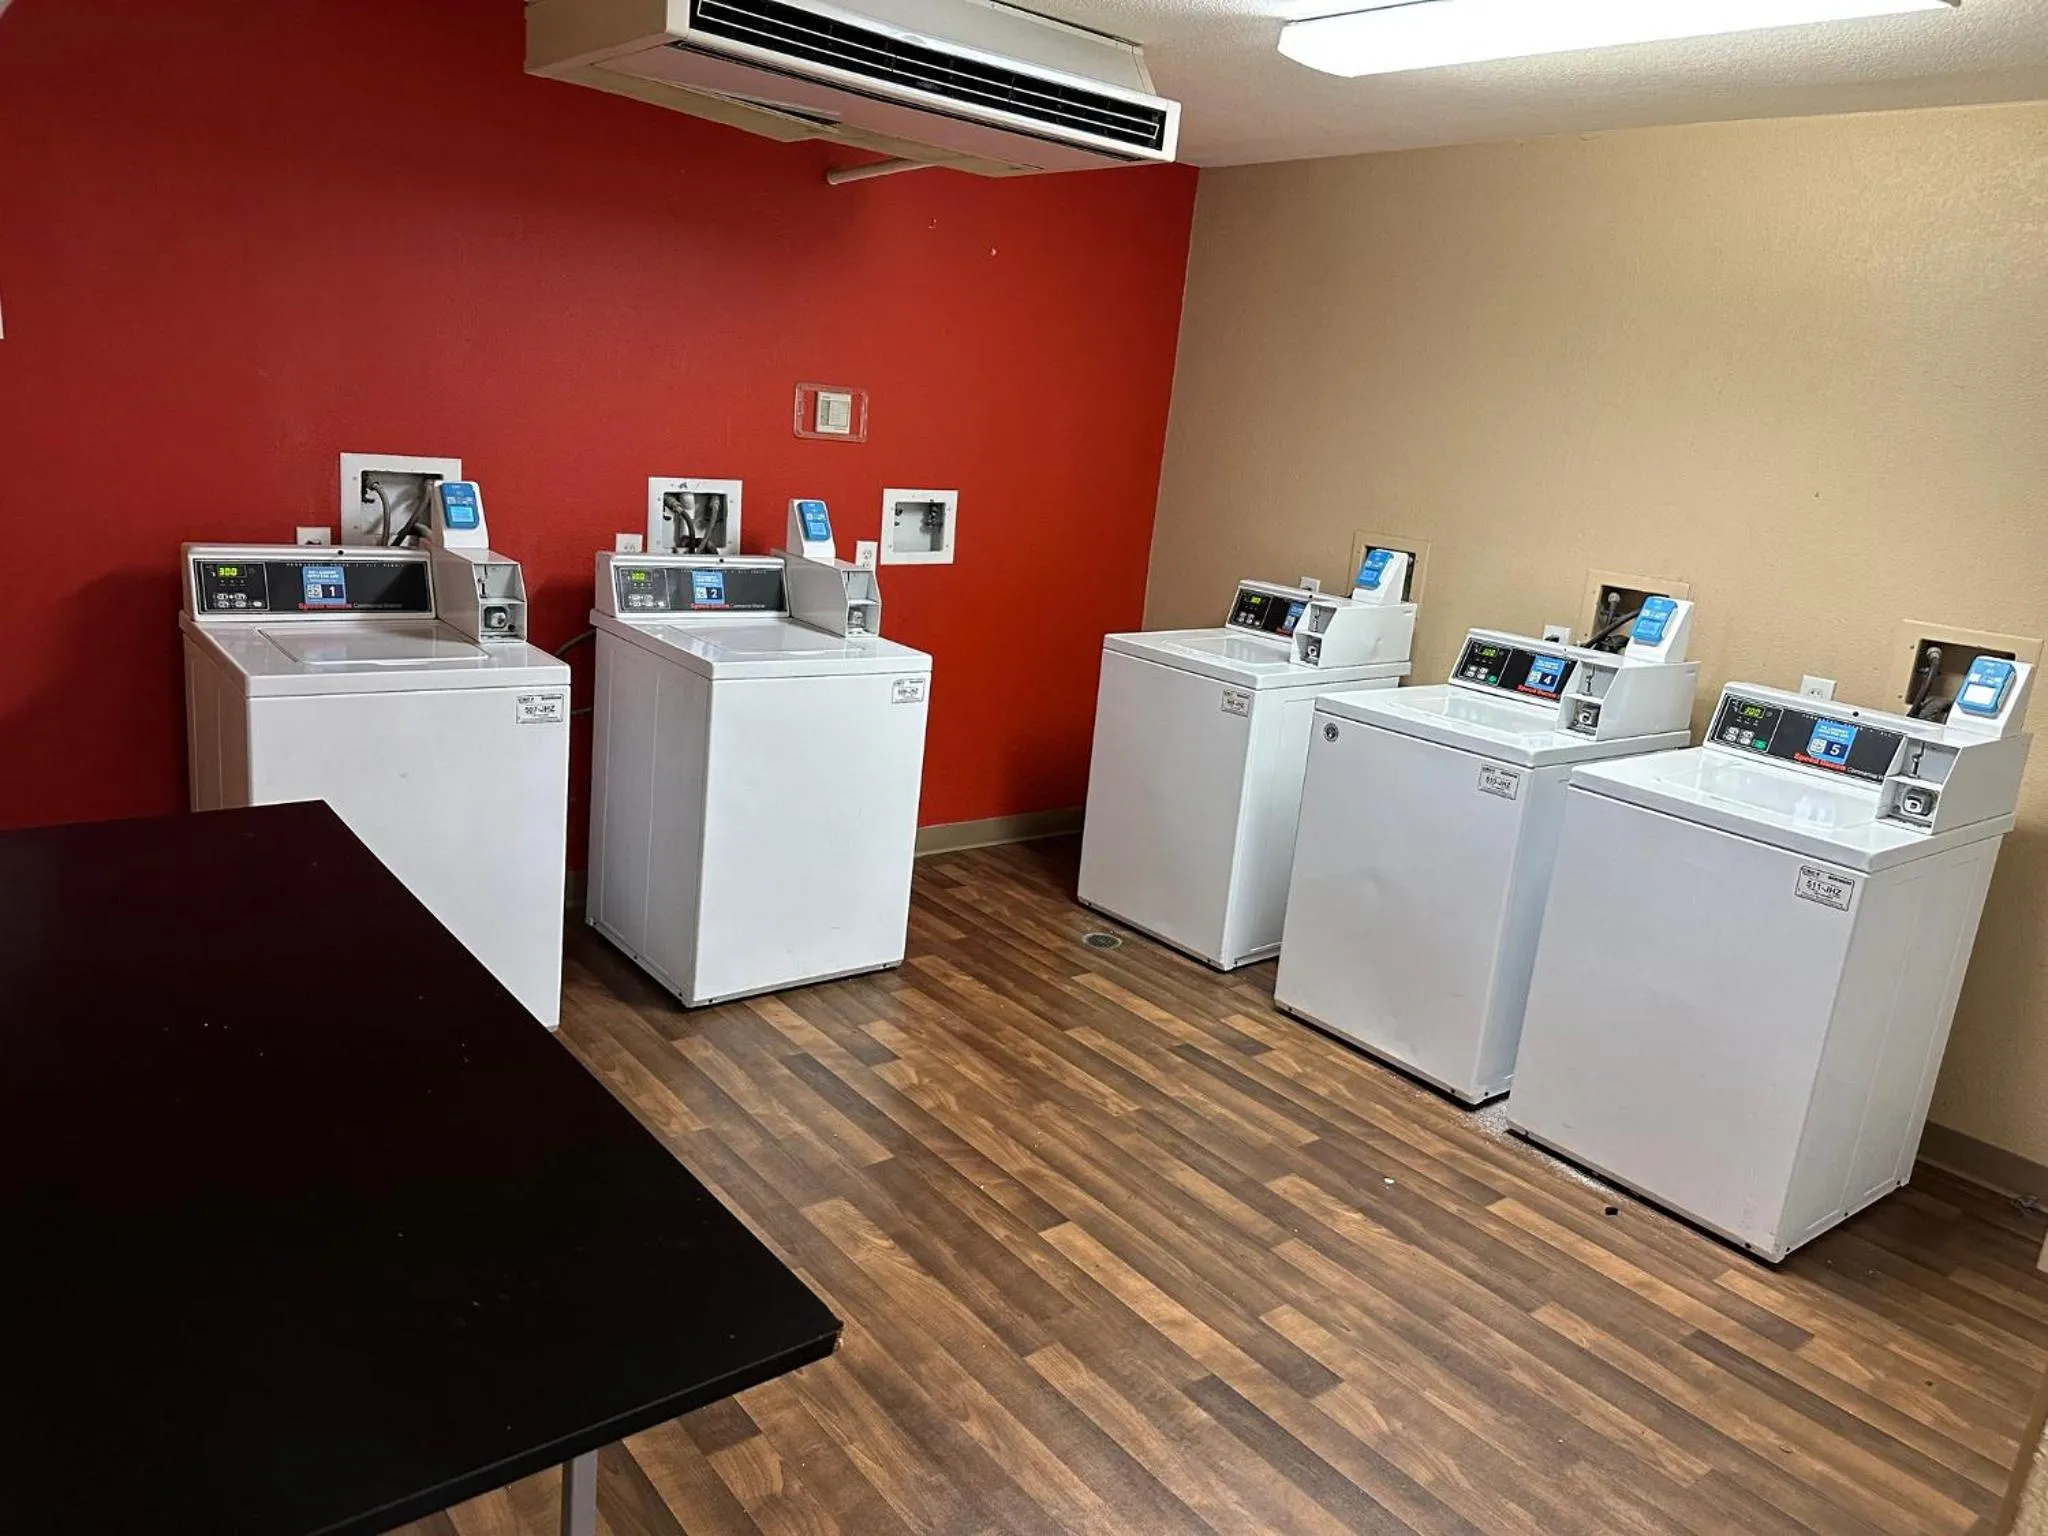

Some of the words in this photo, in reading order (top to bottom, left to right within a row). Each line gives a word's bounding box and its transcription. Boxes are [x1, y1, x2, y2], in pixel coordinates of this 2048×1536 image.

[329, 586, 336, 597] 1
[710, 588, 718, 599] 2
[1543, 675, 1552, 685] 4
[1829, 744, 1842, 756] 5
